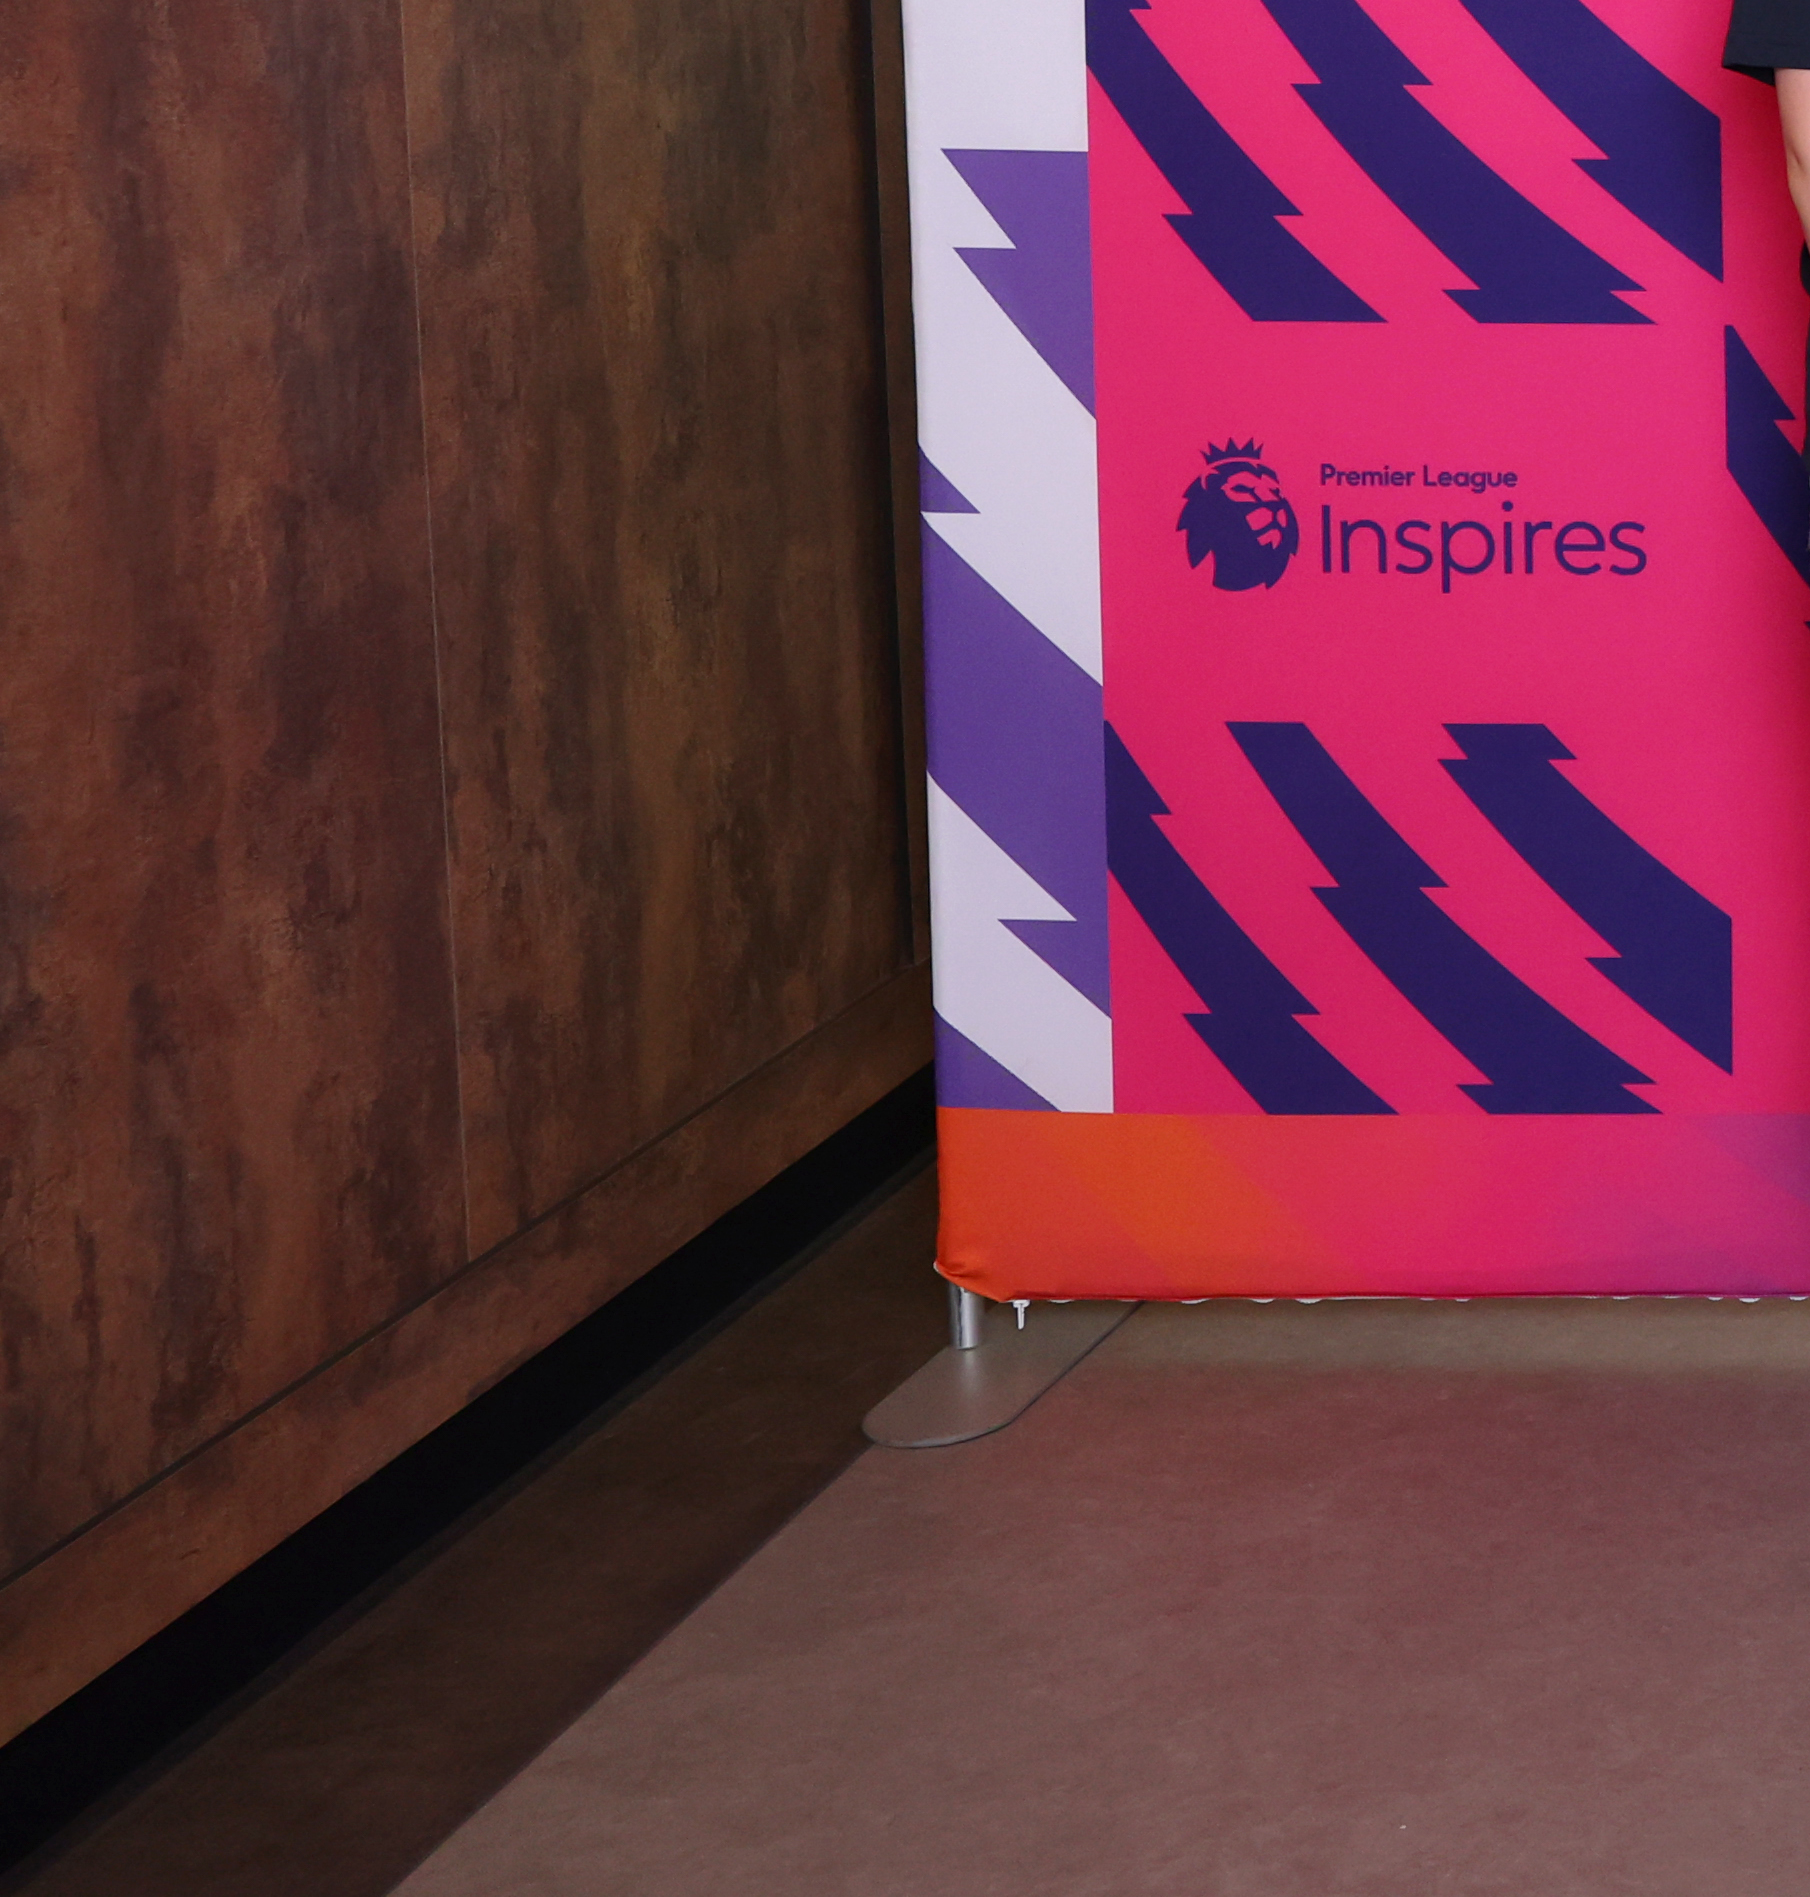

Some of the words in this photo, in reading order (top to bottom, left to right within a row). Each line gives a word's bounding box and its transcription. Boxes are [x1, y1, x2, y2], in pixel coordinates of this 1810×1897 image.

[1320, 463, 1415, 488] Premier
[1422, 465, 1518, 494] League
[1320, 500, 1648, 593] Inspires
